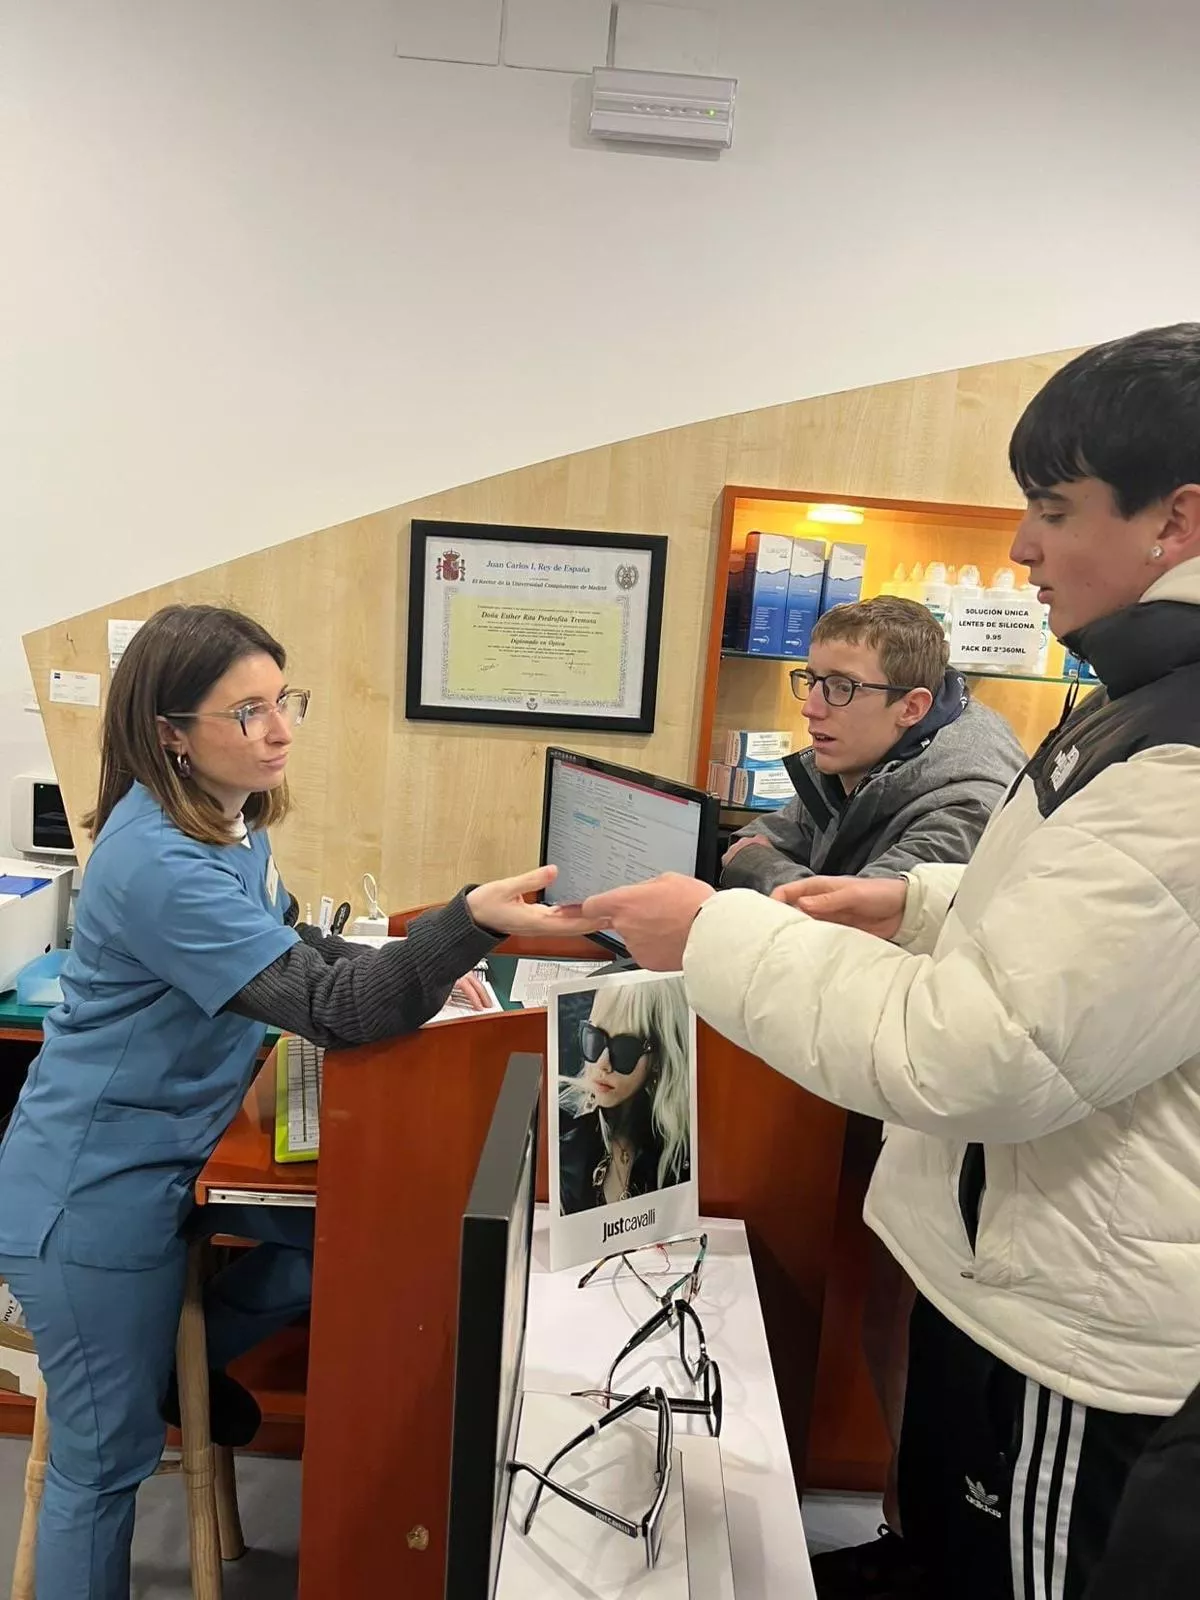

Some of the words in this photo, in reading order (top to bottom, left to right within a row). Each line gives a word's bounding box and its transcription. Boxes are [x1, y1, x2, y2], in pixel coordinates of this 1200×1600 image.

[486, 560, 504, 568] Juan
[506, 561, 529, 570] Carlos
[538, 563, 551, 572] Rey
[564, 564, 591, 573] España
[965, 1494, 1002, 1518] adidas
